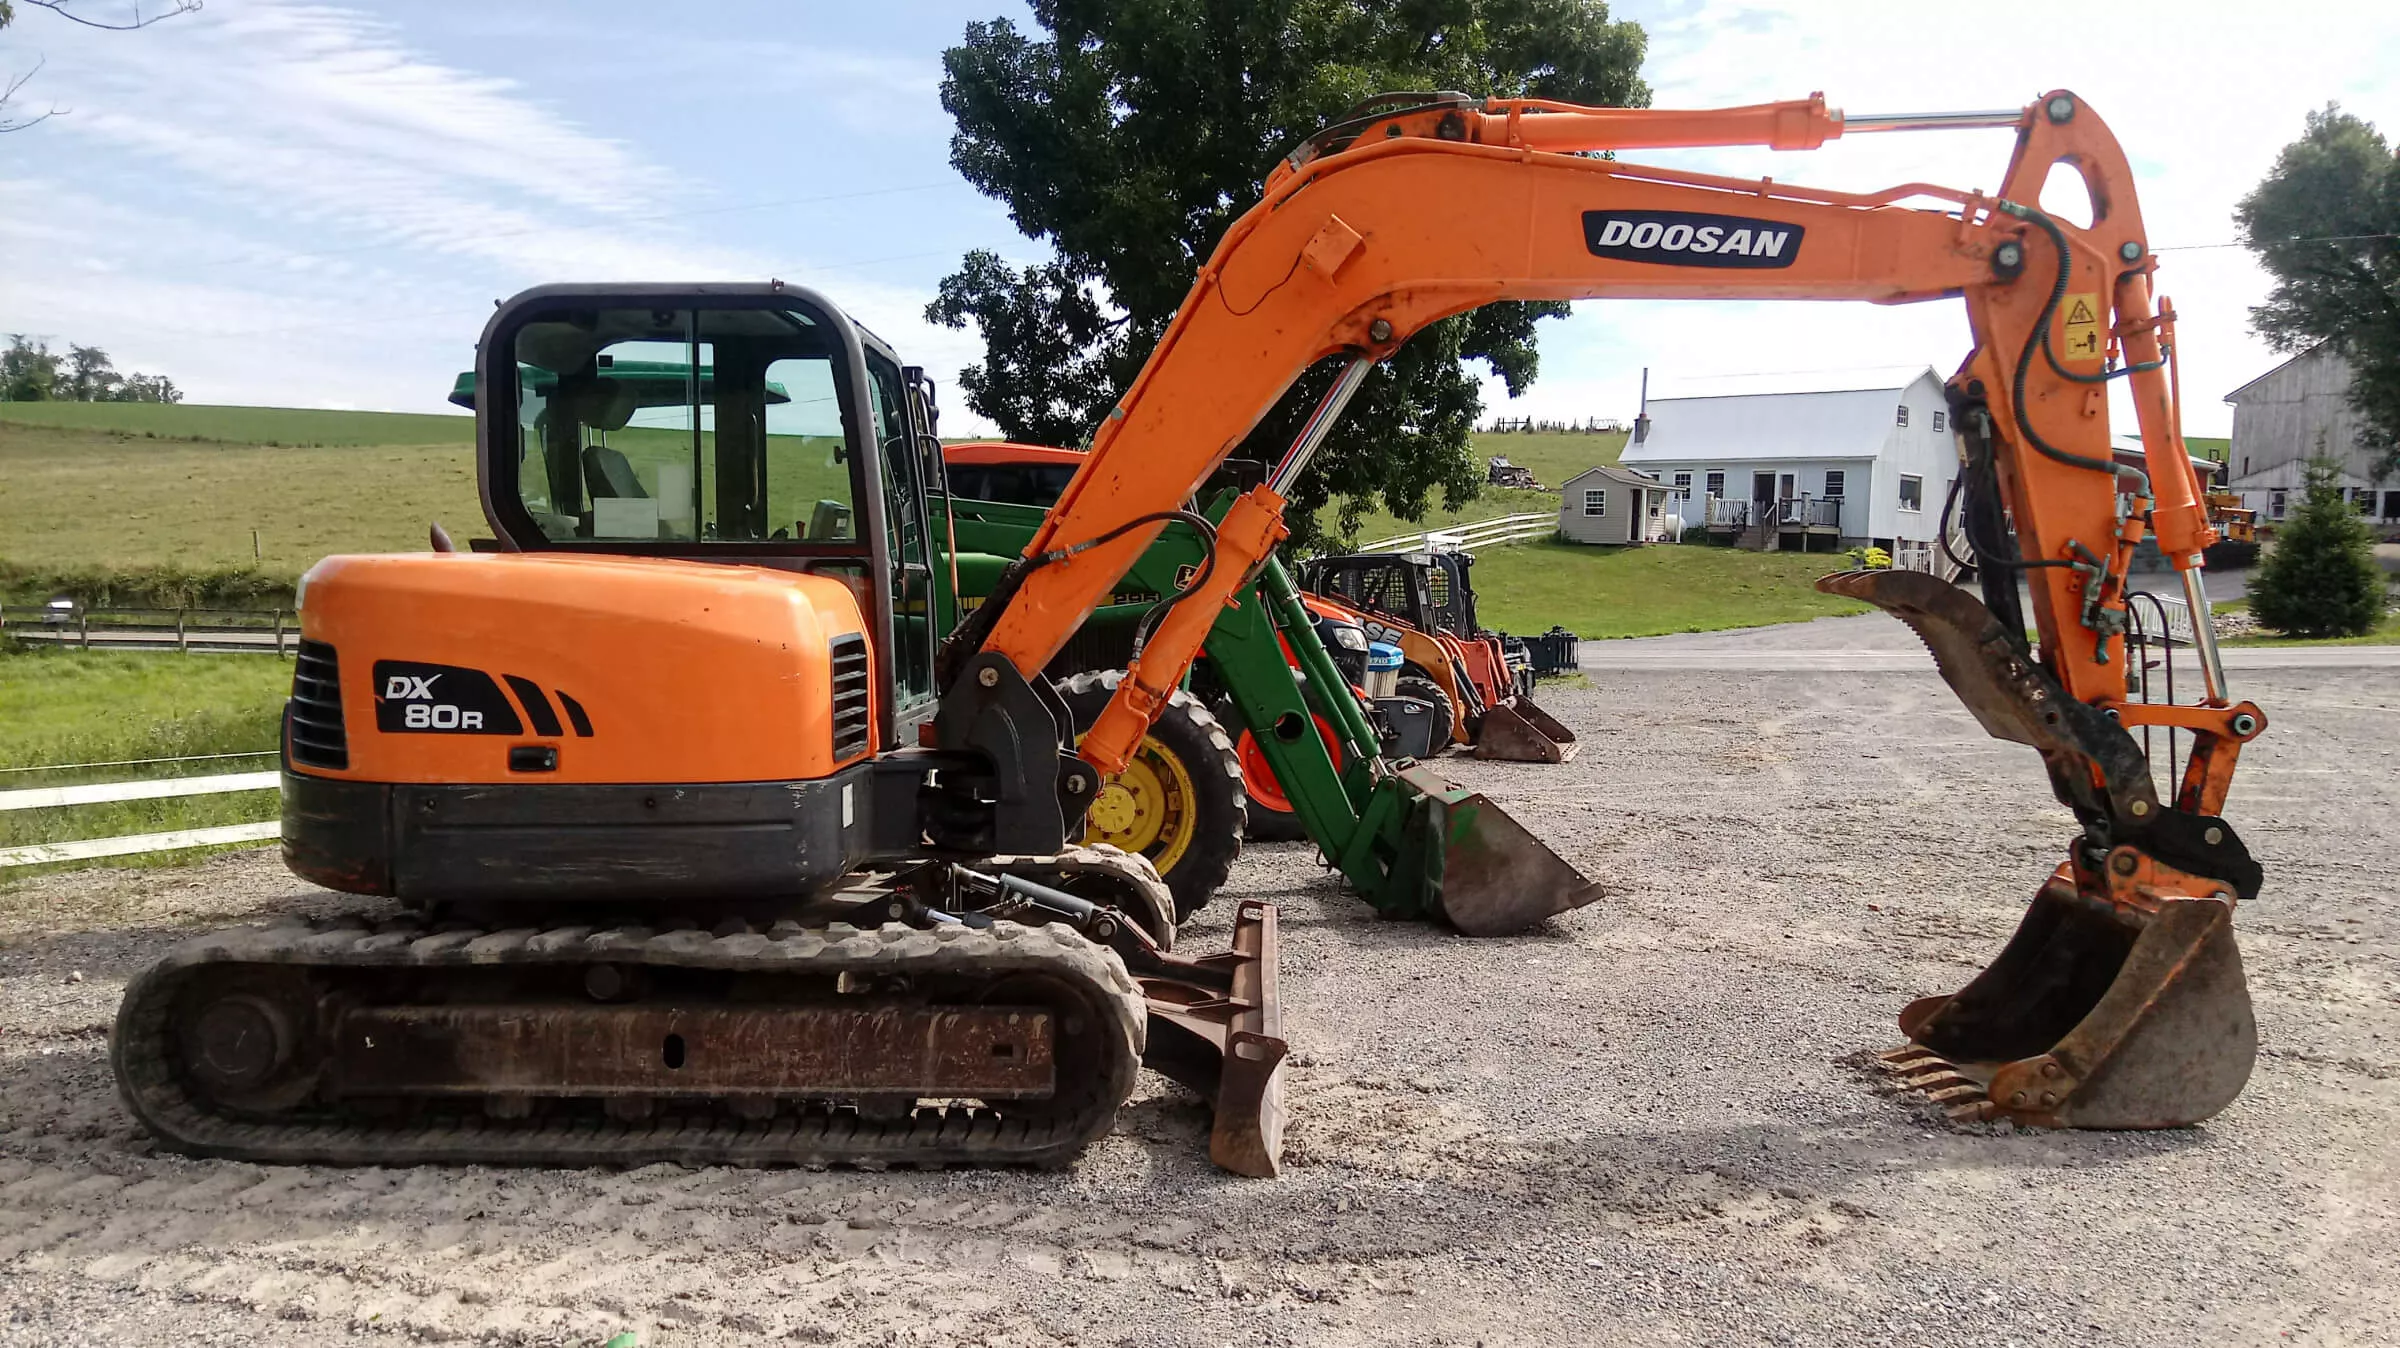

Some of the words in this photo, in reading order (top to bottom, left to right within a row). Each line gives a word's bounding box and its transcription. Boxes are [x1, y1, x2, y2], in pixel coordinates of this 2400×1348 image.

[1598, 220, 1788, 258] DOOSAN
[385, 673, 443, 700] DX
[405, 704, 484, 729] 80R
